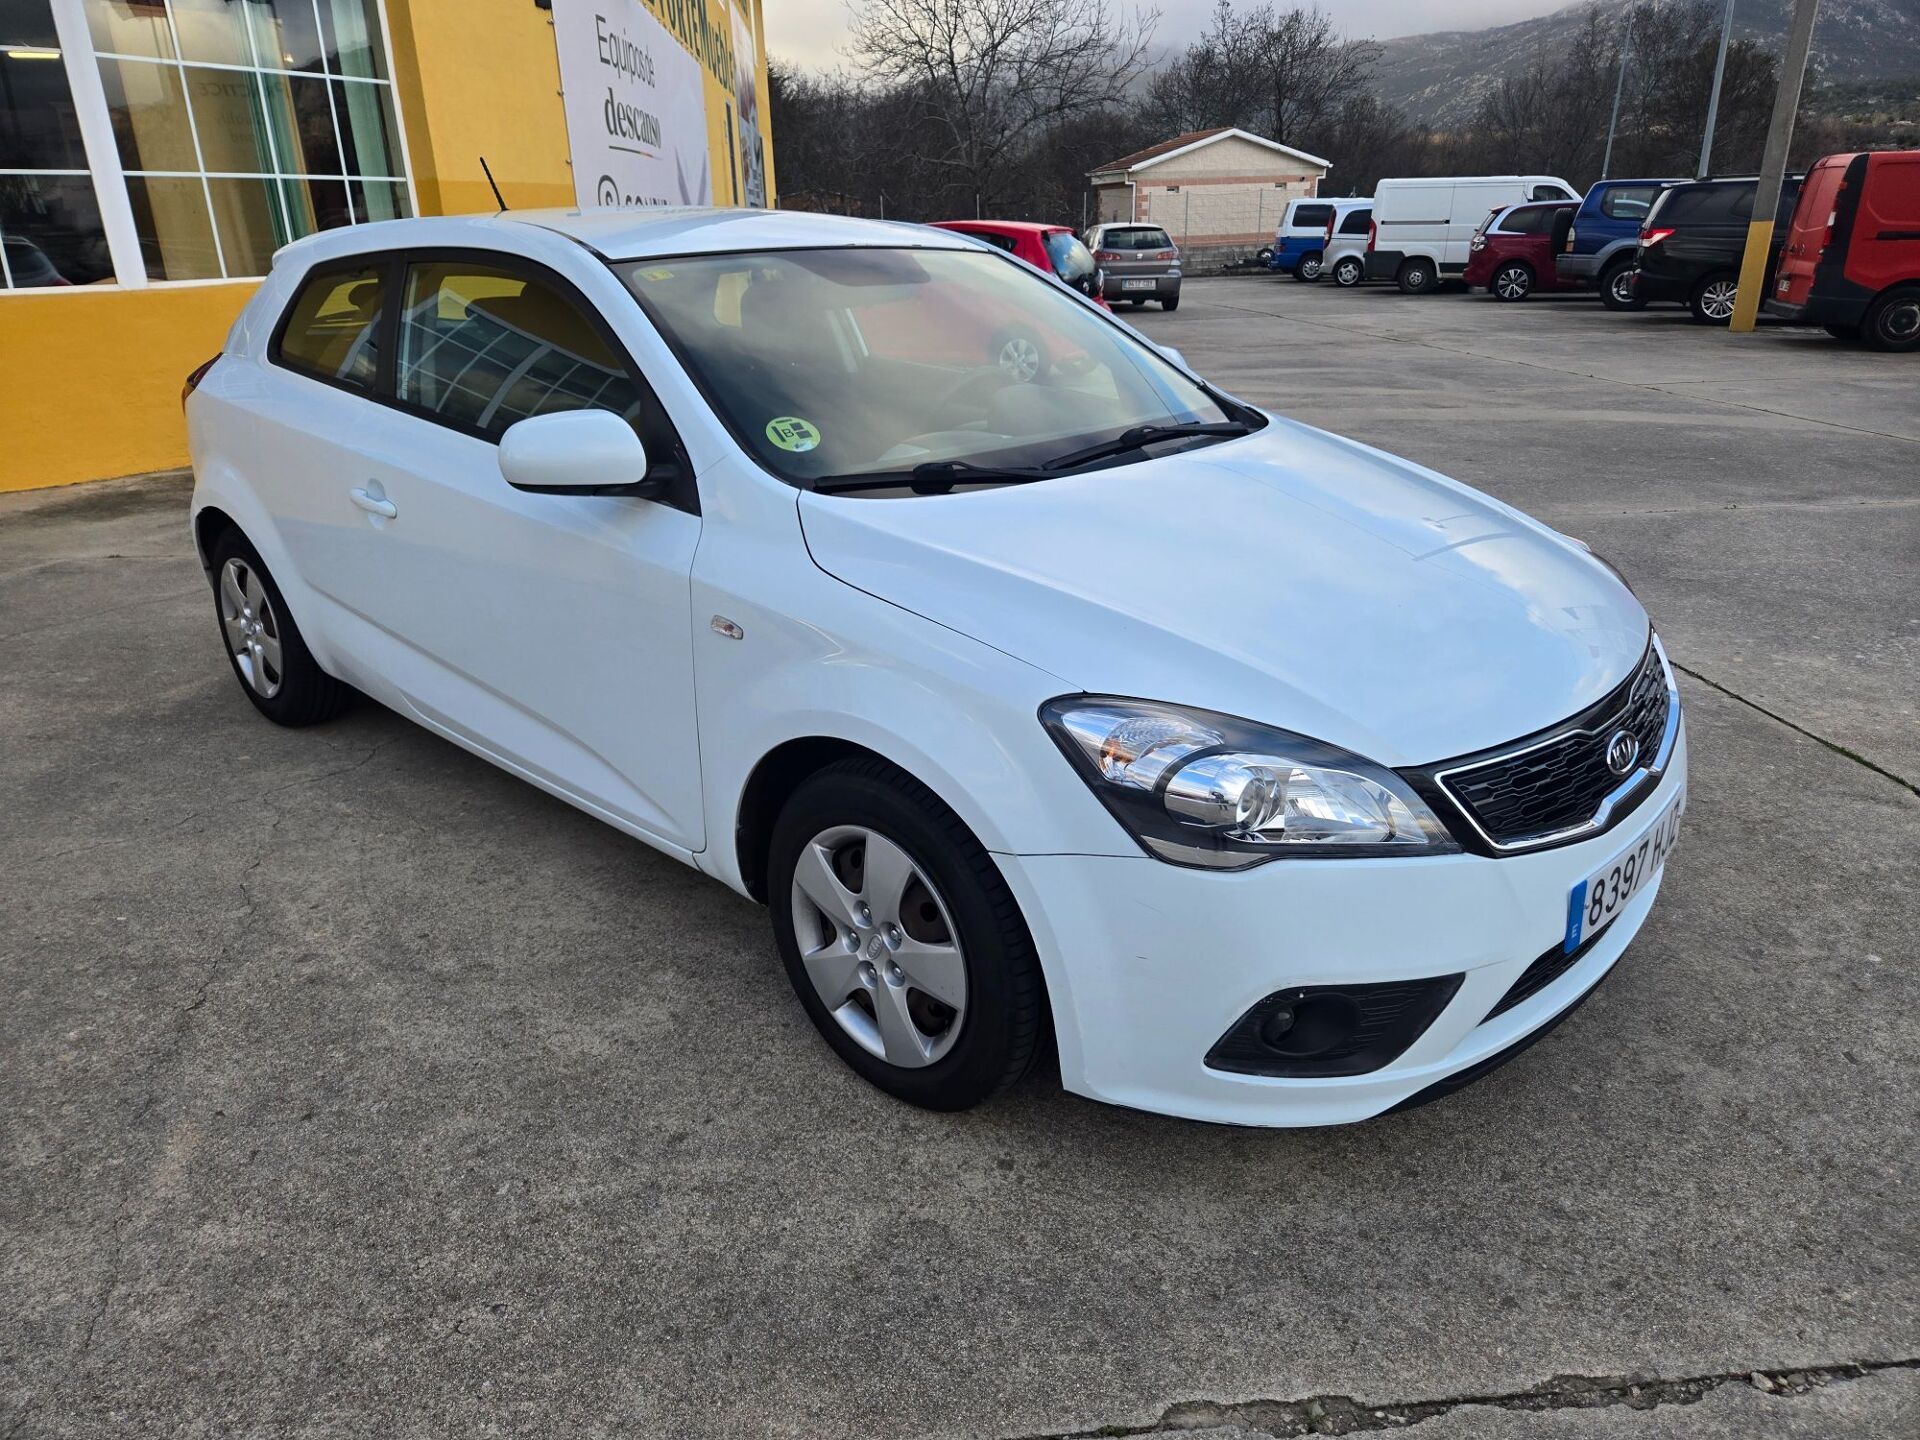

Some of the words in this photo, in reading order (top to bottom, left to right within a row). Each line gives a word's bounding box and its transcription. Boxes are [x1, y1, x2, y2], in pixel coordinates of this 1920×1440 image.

[595, 14, 645, 83] Equipos
[604, 86, 661, 149] descanso
[1588, 838, 1650, 927] 8397
